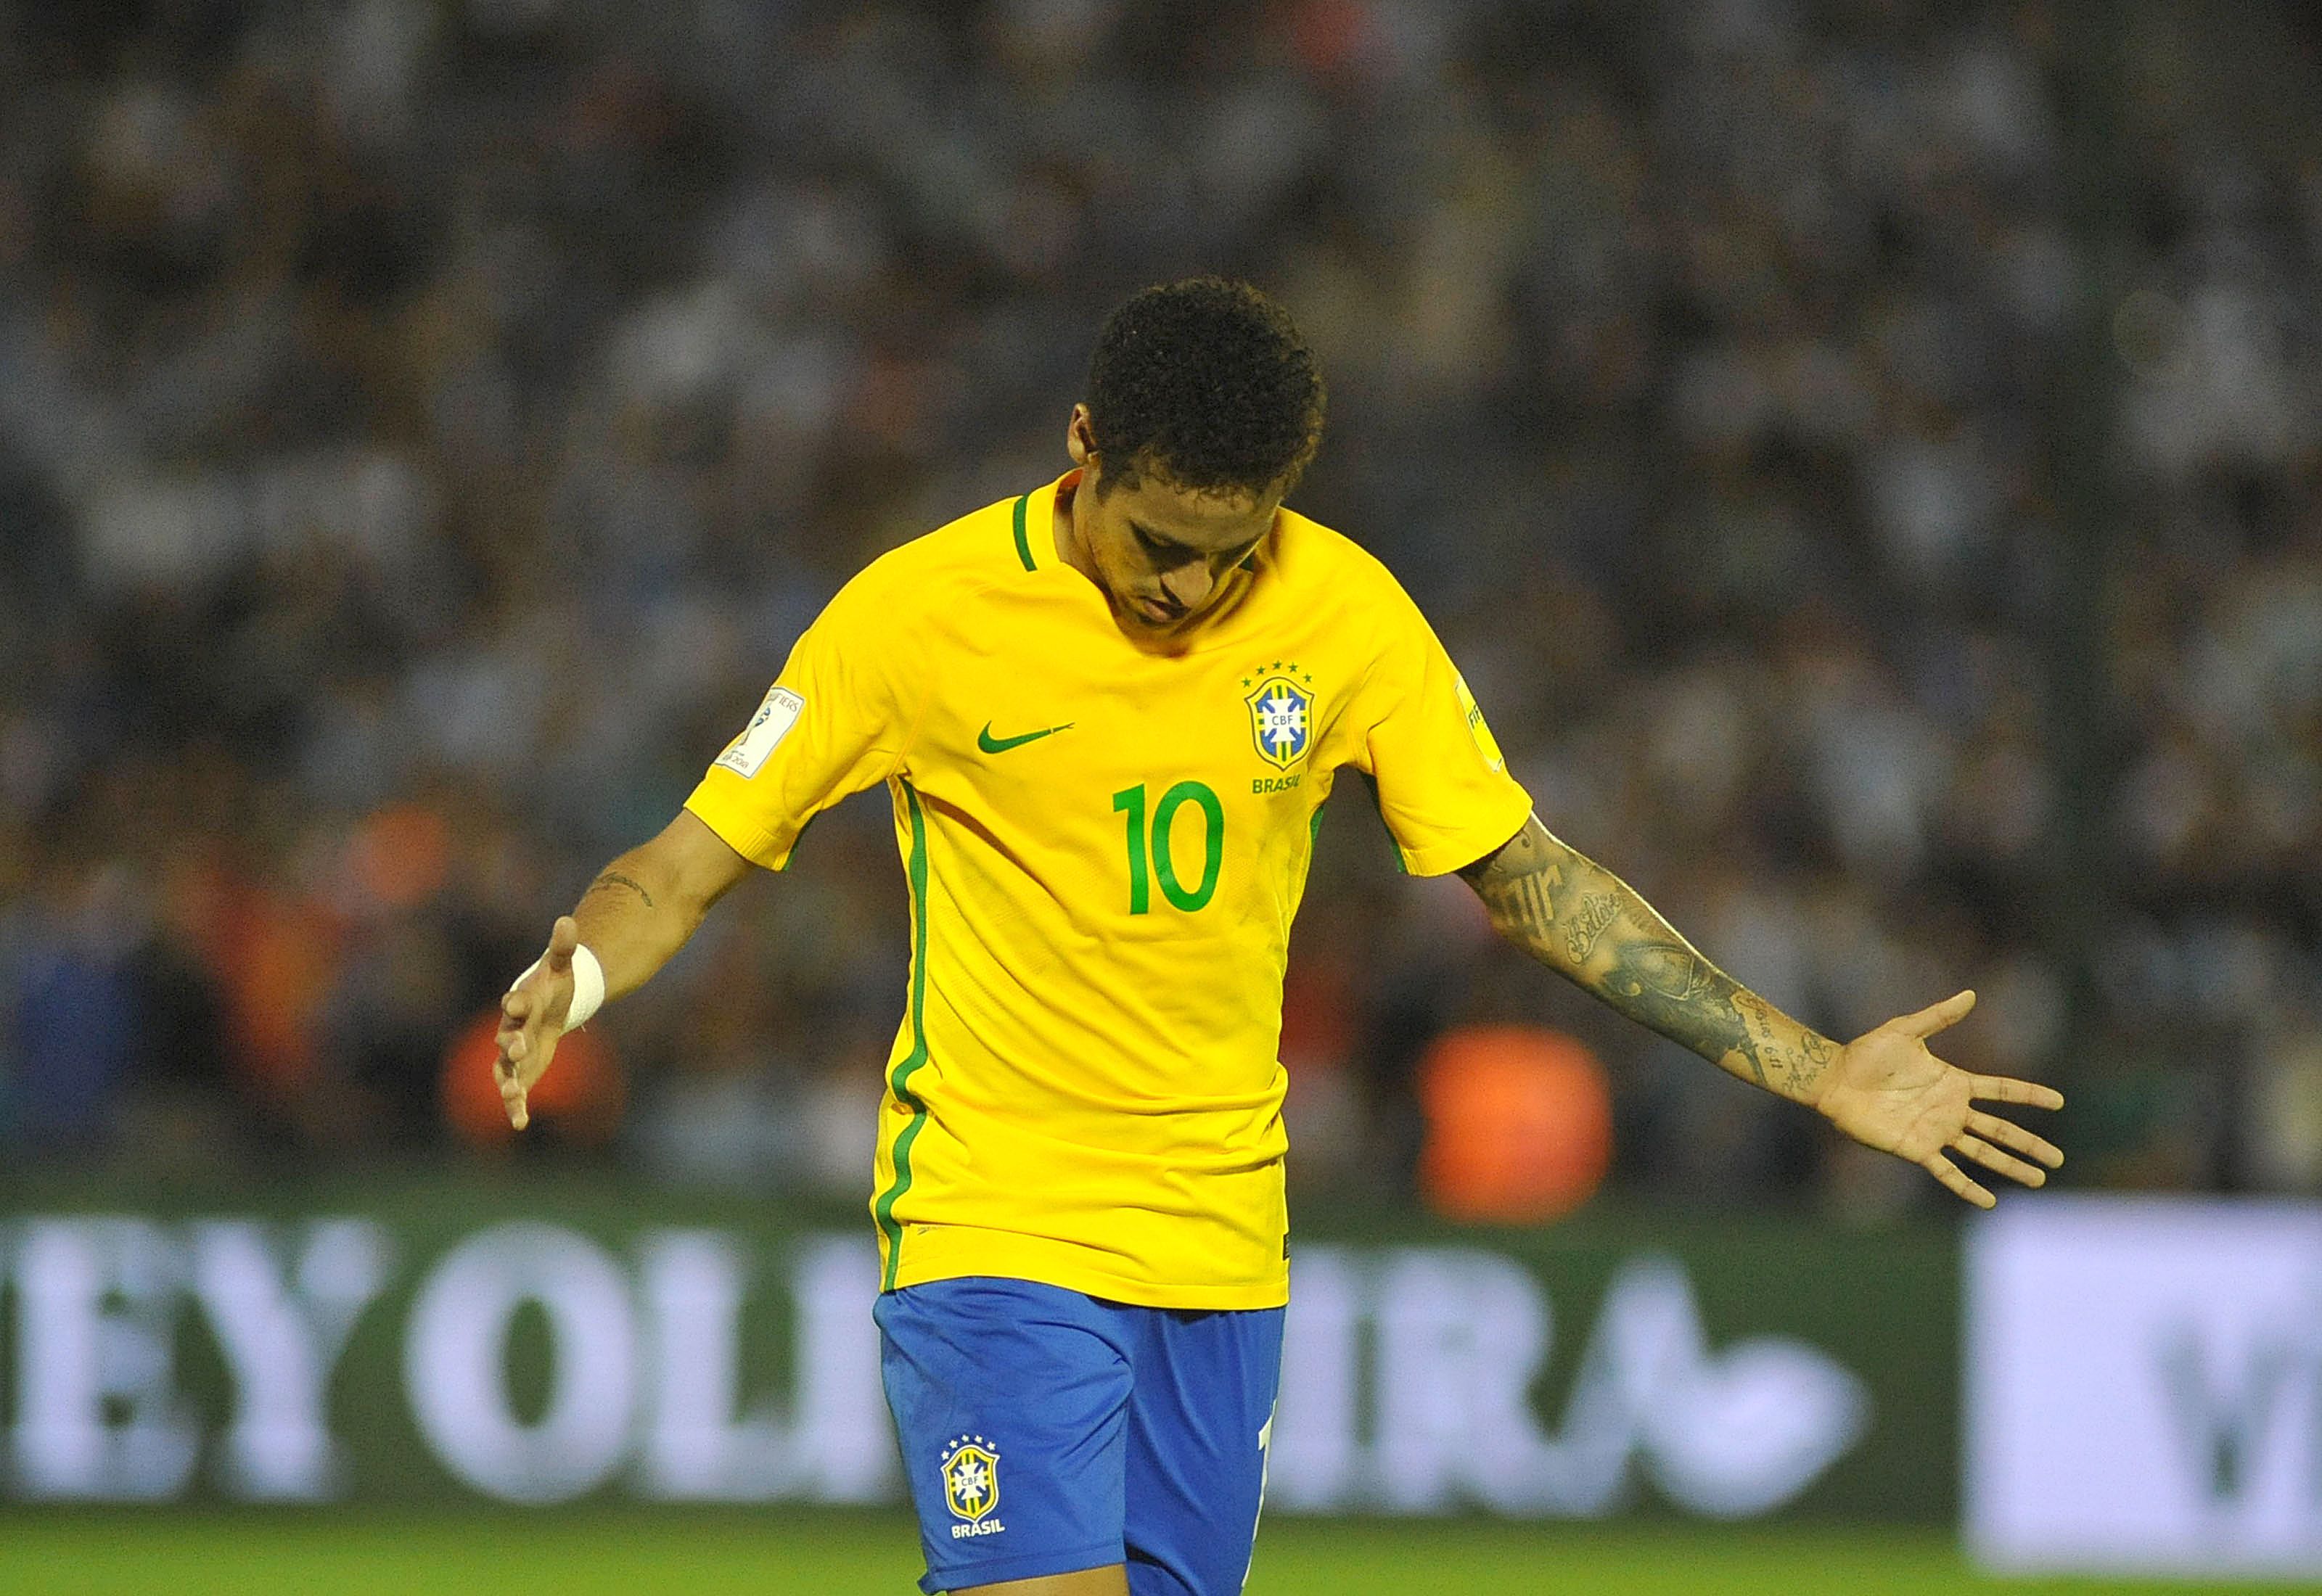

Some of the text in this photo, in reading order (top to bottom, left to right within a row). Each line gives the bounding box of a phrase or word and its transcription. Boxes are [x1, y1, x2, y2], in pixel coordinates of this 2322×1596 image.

[1272, 715, 1293, 725] CBF
[1252, 774, 1301, 794] BRASIL
[1113, 781, 1224, 915] 10
[961, 1476, 979, 1486] CBF
[951, 1518, 1005, 1539] BRASIL
